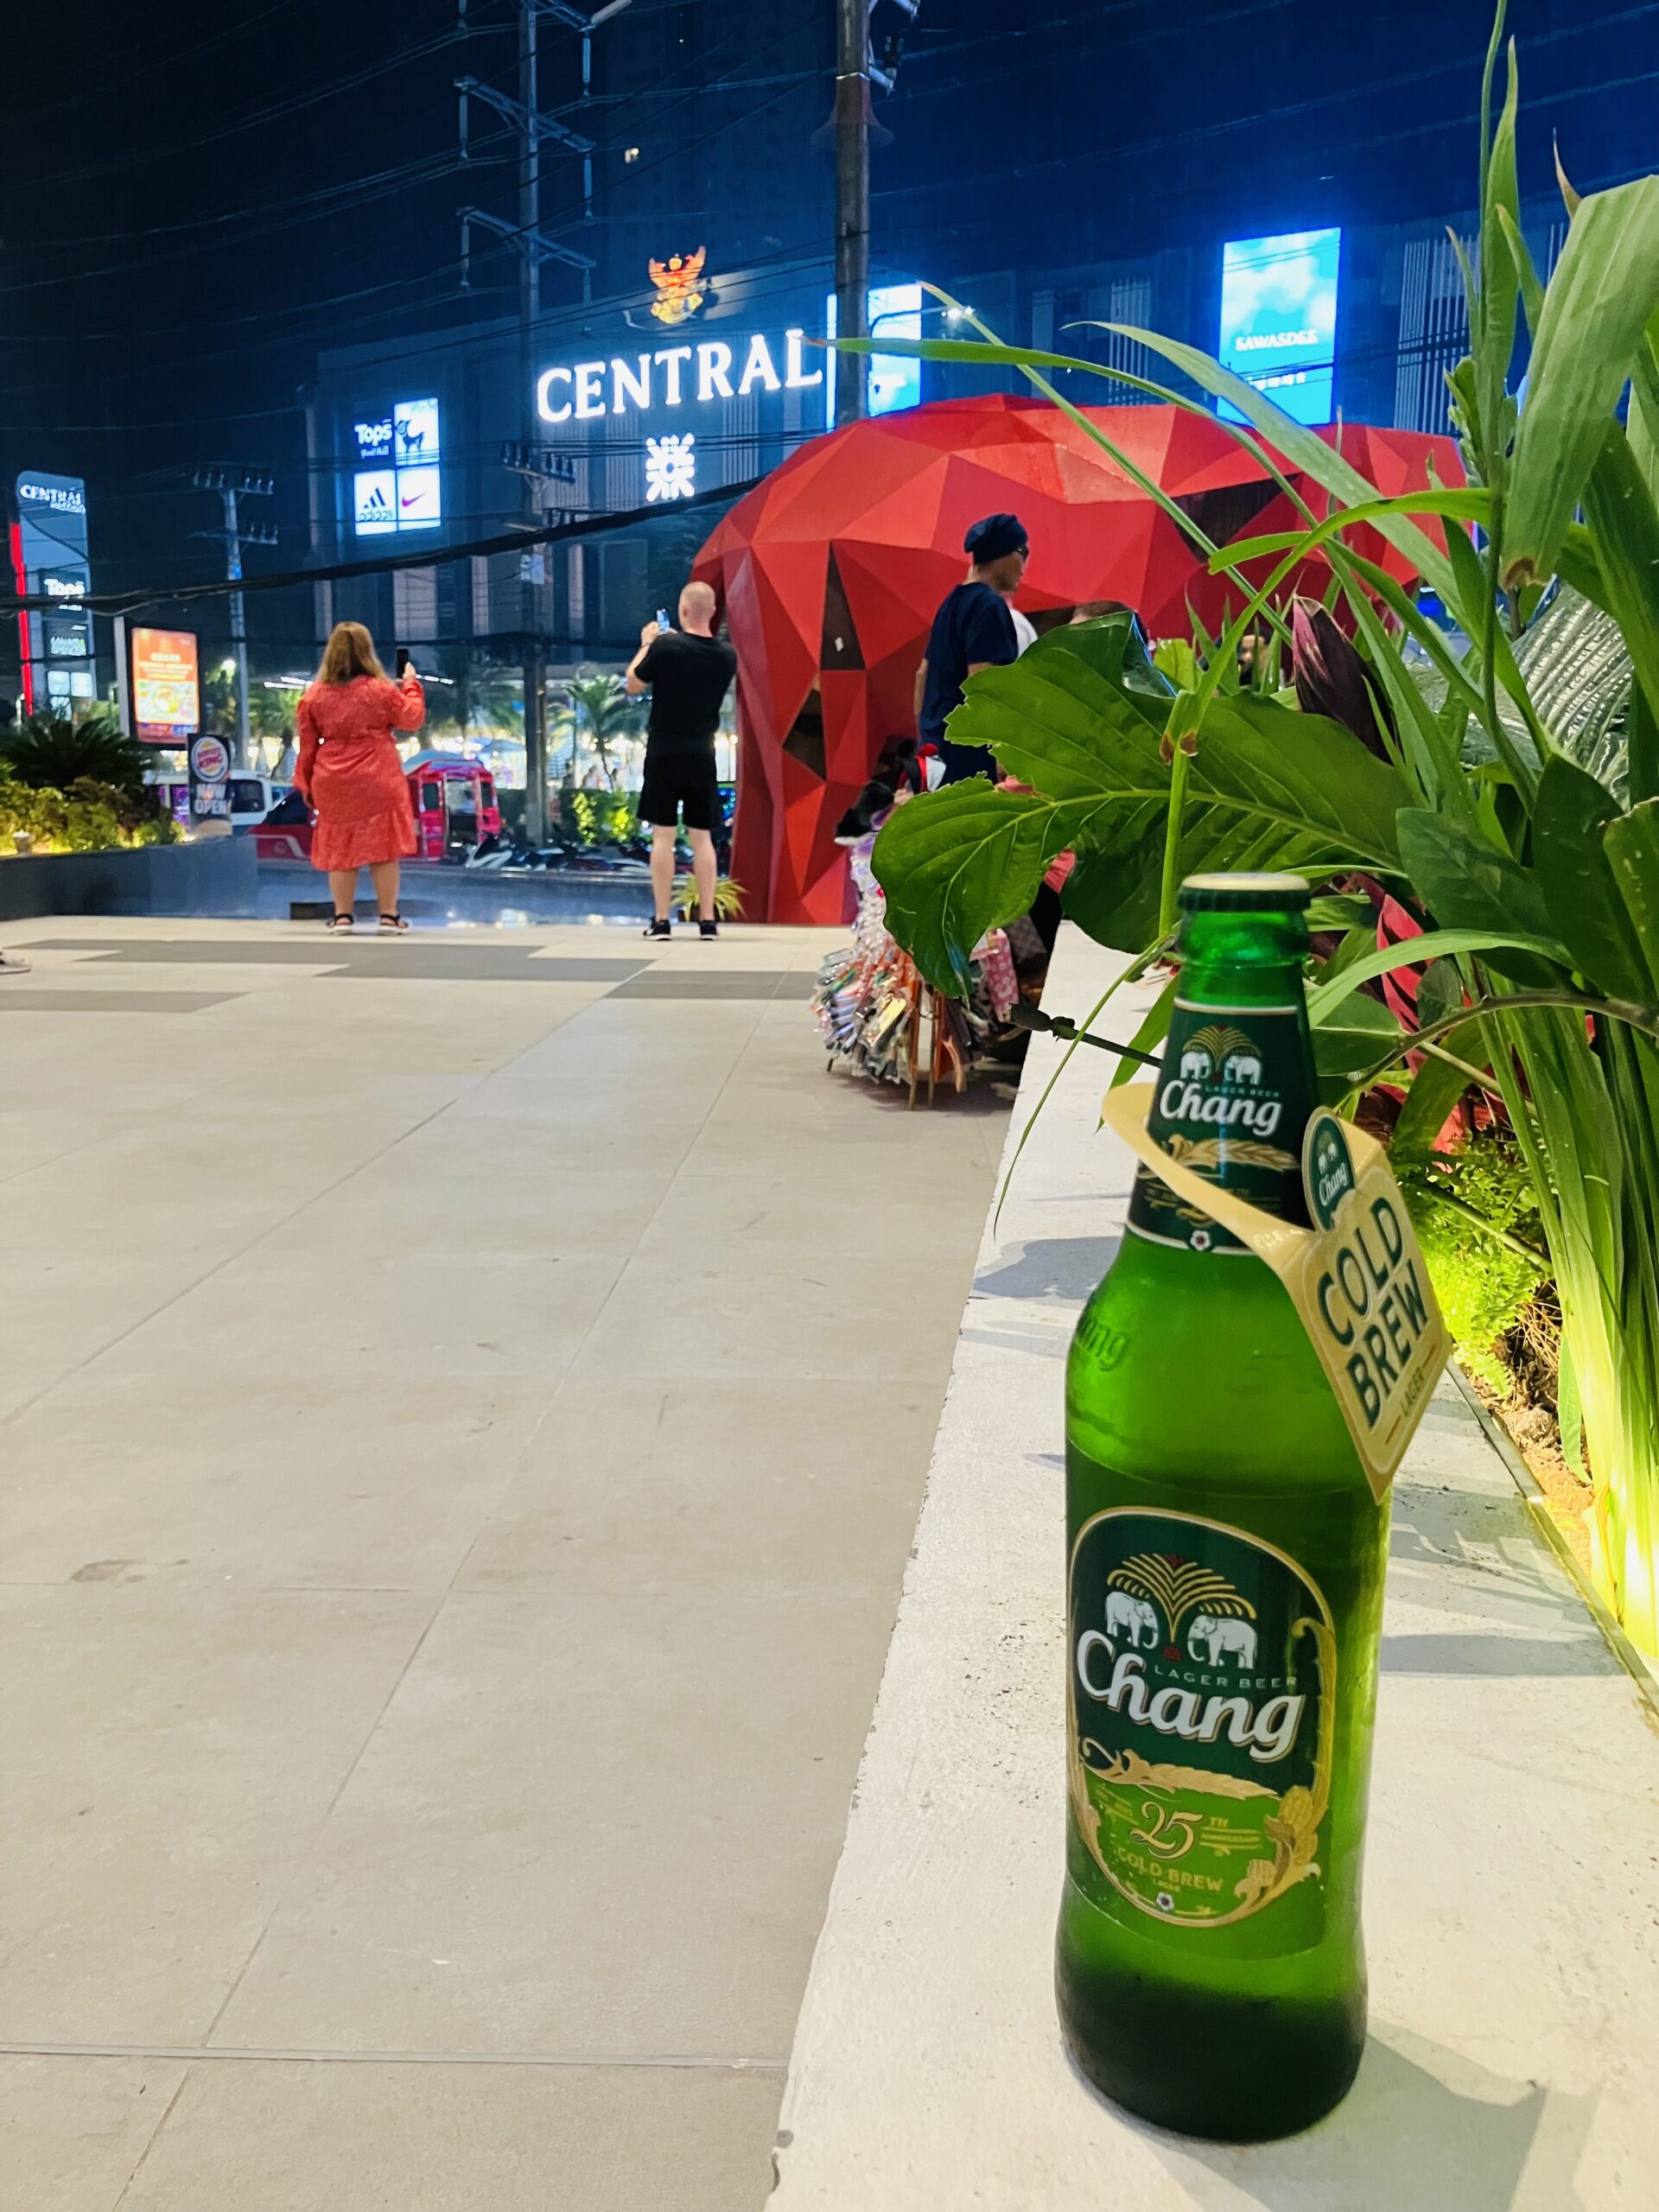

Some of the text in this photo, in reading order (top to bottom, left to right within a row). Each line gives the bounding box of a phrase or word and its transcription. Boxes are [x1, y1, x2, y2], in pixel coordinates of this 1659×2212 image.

[1235, 329, 1319, 352] SAWASDEE
[537, 328, 823, 422] CENTRAL
[355, 419, 393, 447] Tops
[20, 484, 81, 506] CENTRAL
[194, 798, 226, 815] OPEN
[1160, 1080, 1282, 1136] Chang
[1319, 1162, 1348, 1206] Chang
[1317, 1197, 1403, 1347] COLD
[1344, 1258, 1428, 1428] BREW
[1400, 1366, 1426, 1417] LAGER
[1077, 1630, 1306, 1763] Chang
[1154, 1664, 1298, 1689] LAGER BEER
[1129, 1801, 1204, 1859] 25
[1116, 1846, 1224, 1892] COLD BREW
